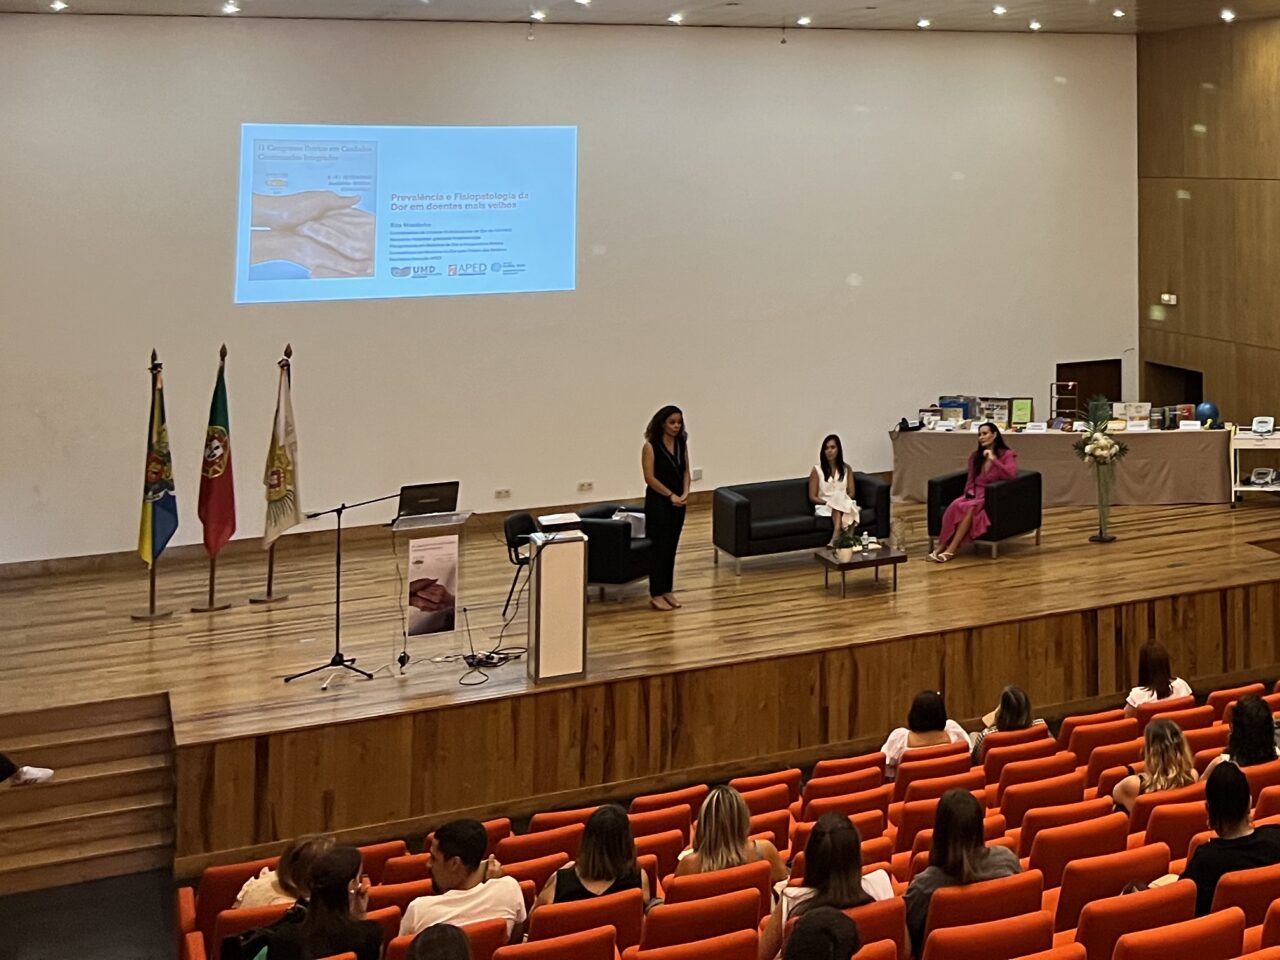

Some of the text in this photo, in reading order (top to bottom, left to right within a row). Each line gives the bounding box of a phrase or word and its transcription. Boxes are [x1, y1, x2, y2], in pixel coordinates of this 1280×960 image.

[391, 193, 444, 202] Prevalência
[453, 192, 516, 203] Fisiopatologia
[390, 203, 408, 211] Dor
[426, 202, 463, 211] doentes
[465, 201, 487, 210] mais
[458, 262, 487, 273] APED
